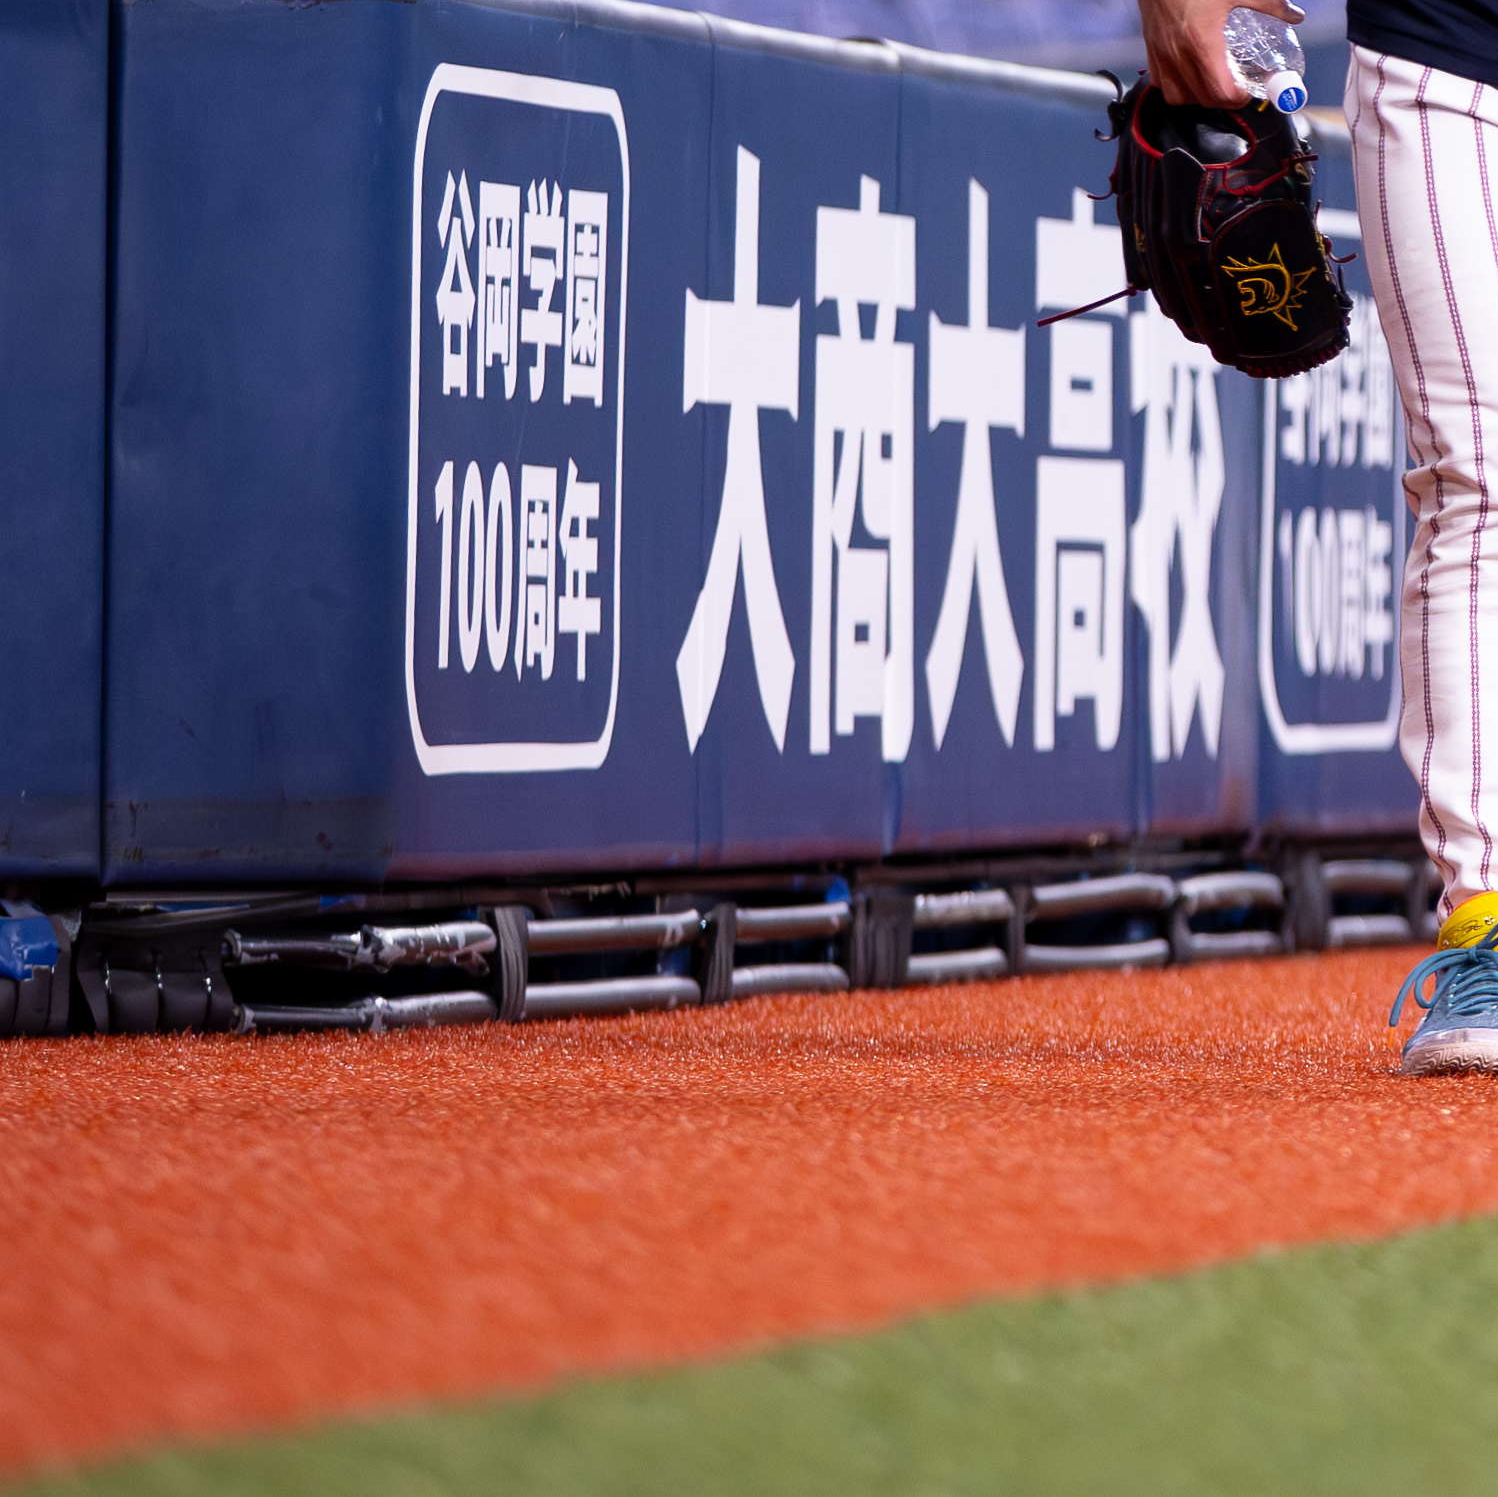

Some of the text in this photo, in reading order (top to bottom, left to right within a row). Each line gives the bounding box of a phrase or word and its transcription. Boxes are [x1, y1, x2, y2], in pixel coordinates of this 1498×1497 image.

[436, 169, 609, 408] 谷岡学園
[434, 457, 602, 683] 100周年
[675, 144, 1226, 763] 大商大高校
